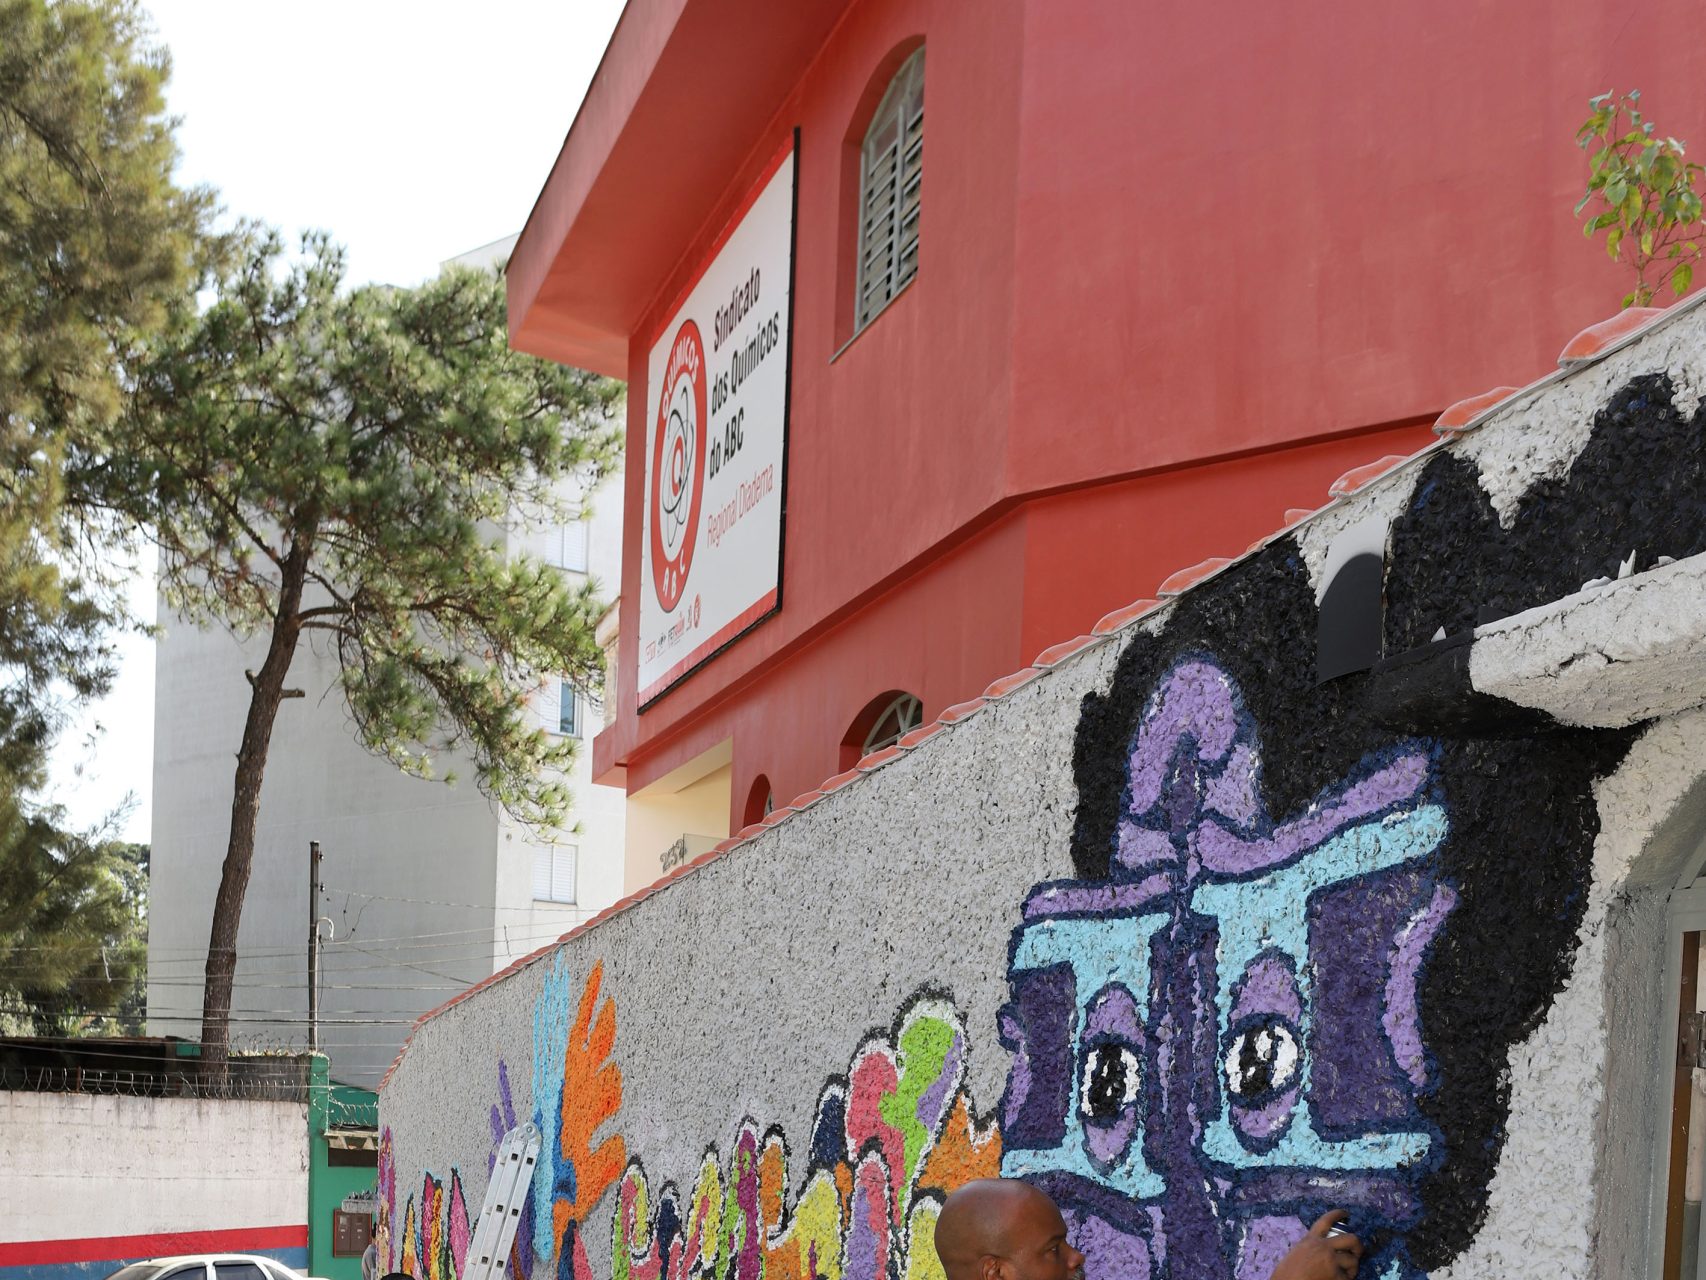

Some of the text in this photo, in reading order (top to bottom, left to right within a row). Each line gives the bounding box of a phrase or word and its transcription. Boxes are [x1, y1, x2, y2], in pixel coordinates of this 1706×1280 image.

[714, 266, 761, 353] Sindicato
[711, 311, 779, 417] dos Químicos
[709, 406, 744, 480] do ABC
[706, 463, 773, 549] Regional Diadema
